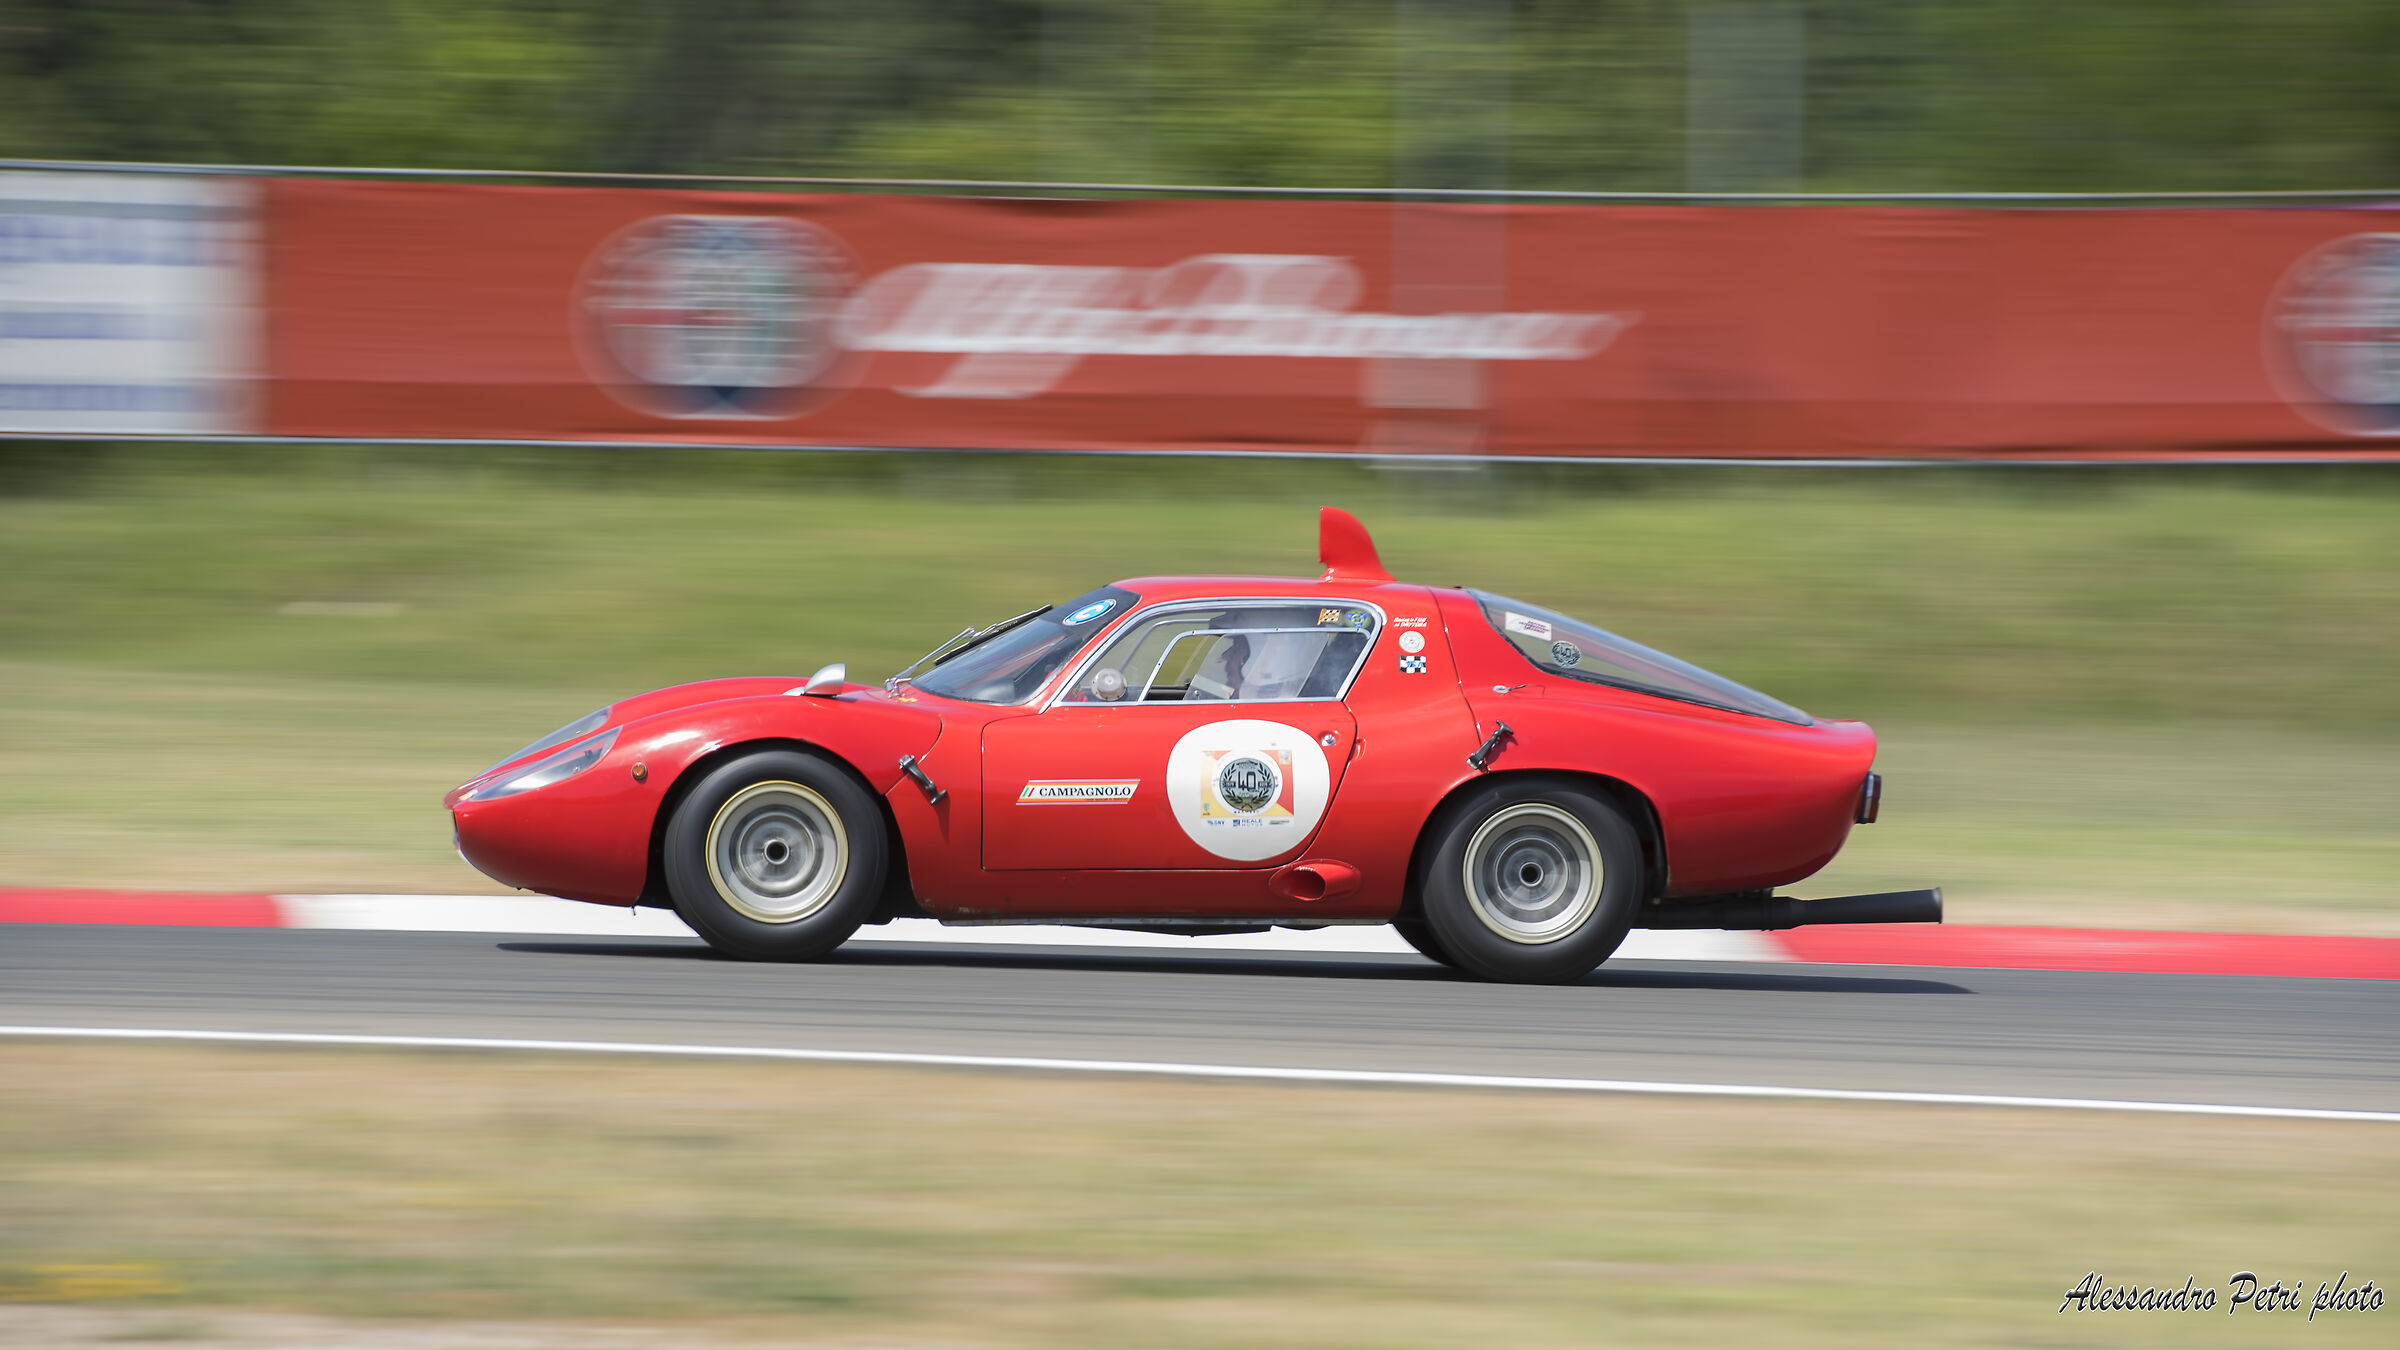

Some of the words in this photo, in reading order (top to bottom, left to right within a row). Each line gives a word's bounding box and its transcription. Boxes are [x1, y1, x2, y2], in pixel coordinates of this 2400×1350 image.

[1075, 604, 1105, 620] C
[1238, 771, 1256, 791] 40
[1039, 786, 1131, 797] CAMPAGNOLO
